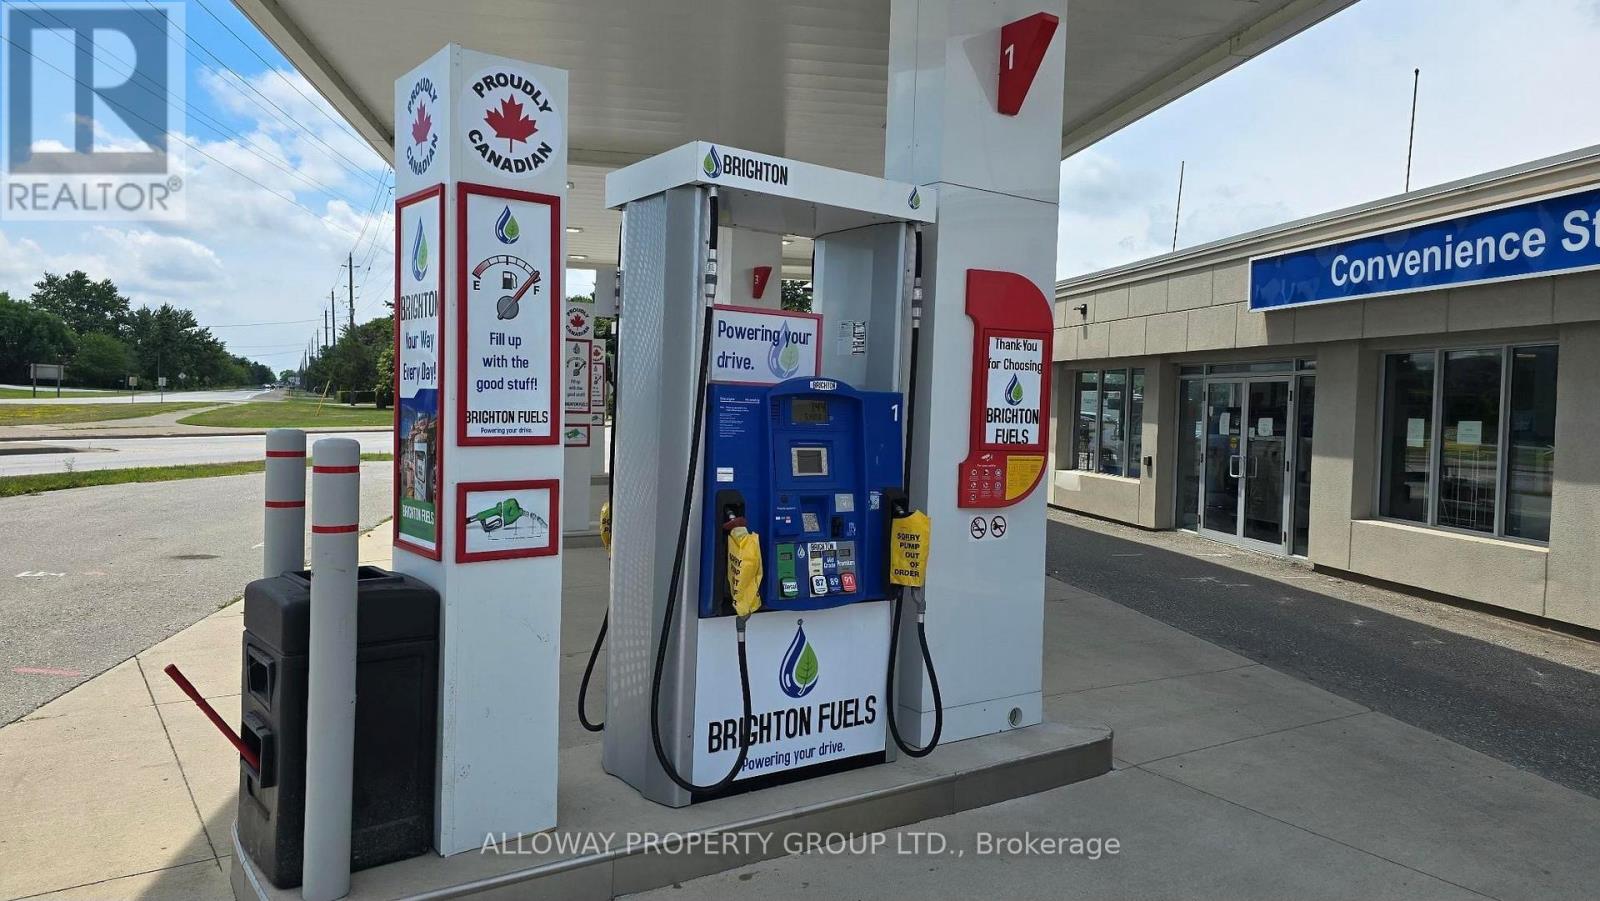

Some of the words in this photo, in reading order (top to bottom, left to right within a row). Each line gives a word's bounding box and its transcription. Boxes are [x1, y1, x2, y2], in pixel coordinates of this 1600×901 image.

[1004, 44, 1014, 70] 1
[408, 77, 438, 115] PROUDLY
[472, 72, 553, 114] PROUDLY
[406, 133, 438, 176] CANADIAN
[468, 129, 553, 174] CANADIAN
[722, 154, 789, 186] BRIGHTON
[1331, 227, 1546, 287] Convenience
[473, 280, 480, 290] E
[533, 286, 540, 295] F
[566, 307, 590, 318] PROUDLY
[565, 325, 590, 336] CANADIAN
[718, 320, 781, 347] Powering
[785, 329, 812, 348] your
[420, 329, 435, 353] Way
[489, 332, 505, 346] Fill
[508, 336, 522, 350] up
[482, 355, 508, 369] with
[511, 356, 529, 369] the
[717, 351, 755, 371] drive.
[988, 357, 1001, 370] for
[1003, 358, 1043, 375] Choosing
[403, 362, 420, 386] Every
[421, 361, 436, 386] Day!
[476, 377, 504, 392] good
[507, 379, 538, 391] stuff!
[466, 410, 515, 424] BRIGHTON
[518, 411, 549, 424] FUELS
[891, 404, 899, 422] 1
[986, 408, 1039, 425] BRIGHTON
[480, 427, 505, 435] Powering
[995, 429, 1029, 444] FUELS
[897, 532, 920, 542] SORRY
[899, 542, 920, 550] PUMP
[905, 551, 920, 560] OUT
[894, 568, 920, 578] ORDER
[910, 561, 919, 569] OF
[815, 578, 824, 587] 87
[844, 576, 853, 584] 91
[708, 706, 812, 753] BRIGHTON
[818, 695, 877, 733] FUELS
[742, 751, 791, 772] Powering
[794, 747, 816, 764] your
[818, 740, 846, 757] drive.
